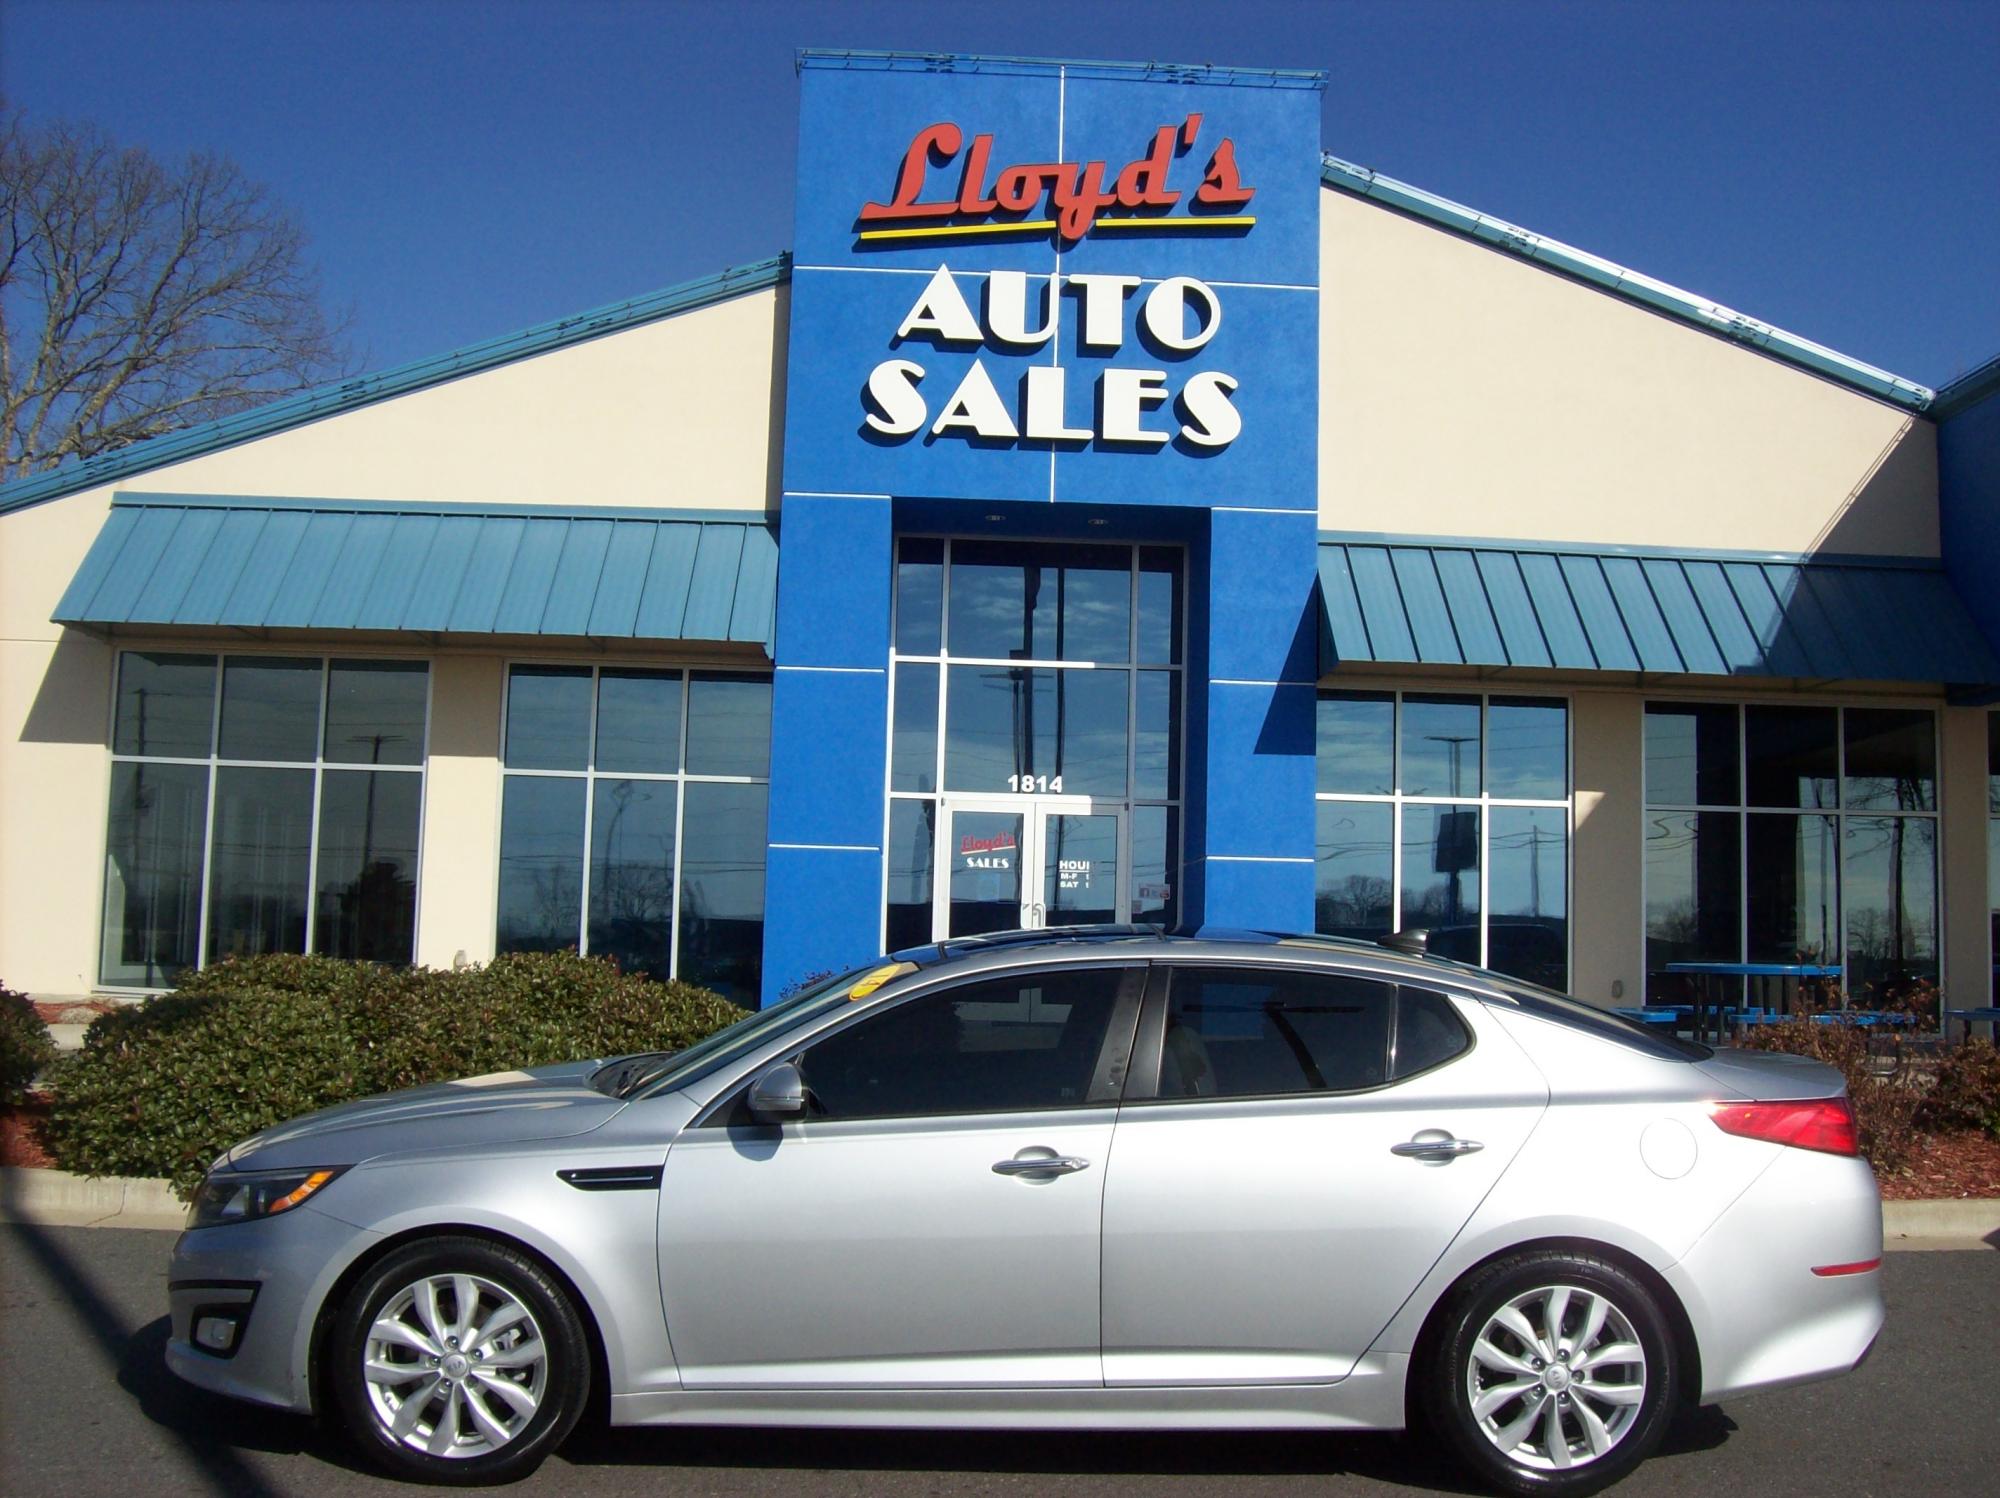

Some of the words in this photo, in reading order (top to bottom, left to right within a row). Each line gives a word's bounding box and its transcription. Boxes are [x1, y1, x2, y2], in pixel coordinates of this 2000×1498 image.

[859, 113, 1256, 240] Lloyd's
[897, 263, 1222, 350] AUTO
[866, 358, 1242, 446] SALES
[1007, 774, 1063, 793] 1814
[966, 857, 1009, 868] SALES
[1060, 872, 1078, 880] M-F
[1060, 880, 1079, 888] SAT
